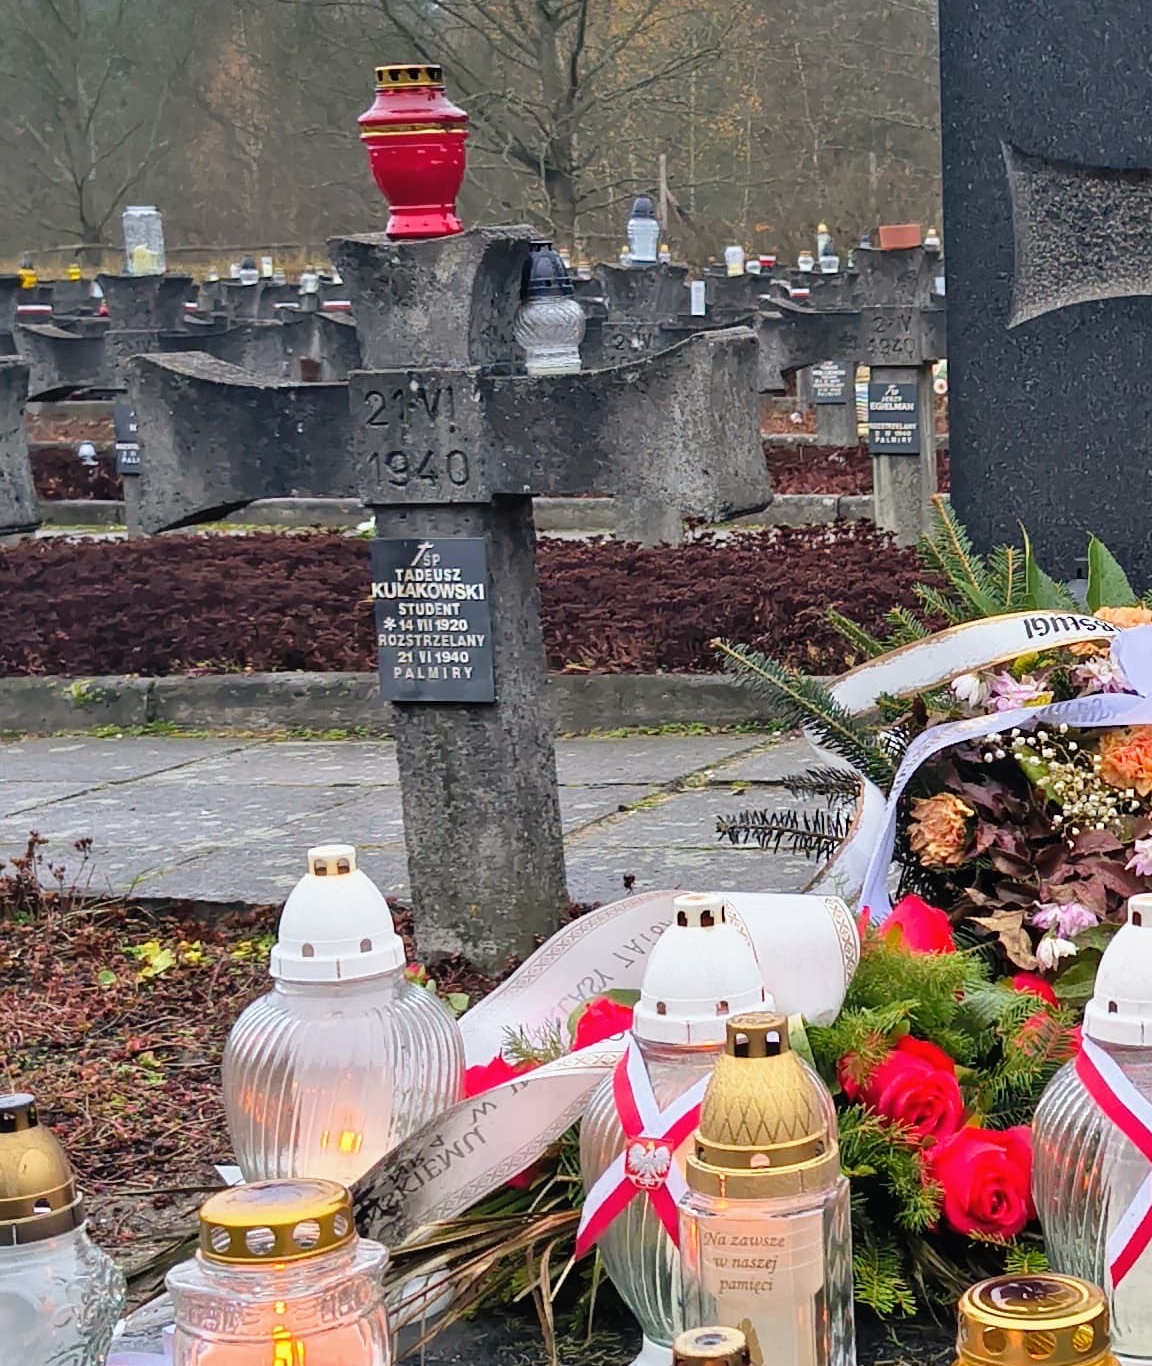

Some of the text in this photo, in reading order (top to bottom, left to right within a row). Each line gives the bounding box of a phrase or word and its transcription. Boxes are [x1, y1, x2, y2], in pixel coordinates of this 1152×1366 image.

[368, 449, 470, 486] 1940
[394, 568, 462, 582] TADEUSZ
[371, 582, 485, 601] KUŁAKOWSKI
[398, 602, 461, 616] STUDENT
[434, 618, 469, 632] 1920
[377, 634, 486, 647] ROZSTRZELANY
[397, 650, 470, 664] 21 VI 1940
[393, 666, 473, 680] PALMIRY
[703, 1232, 785, 1247] Na zawsze
[731, 1254, 780, 1274] naszej
[718, 1277, 774, 1295] pamięci
